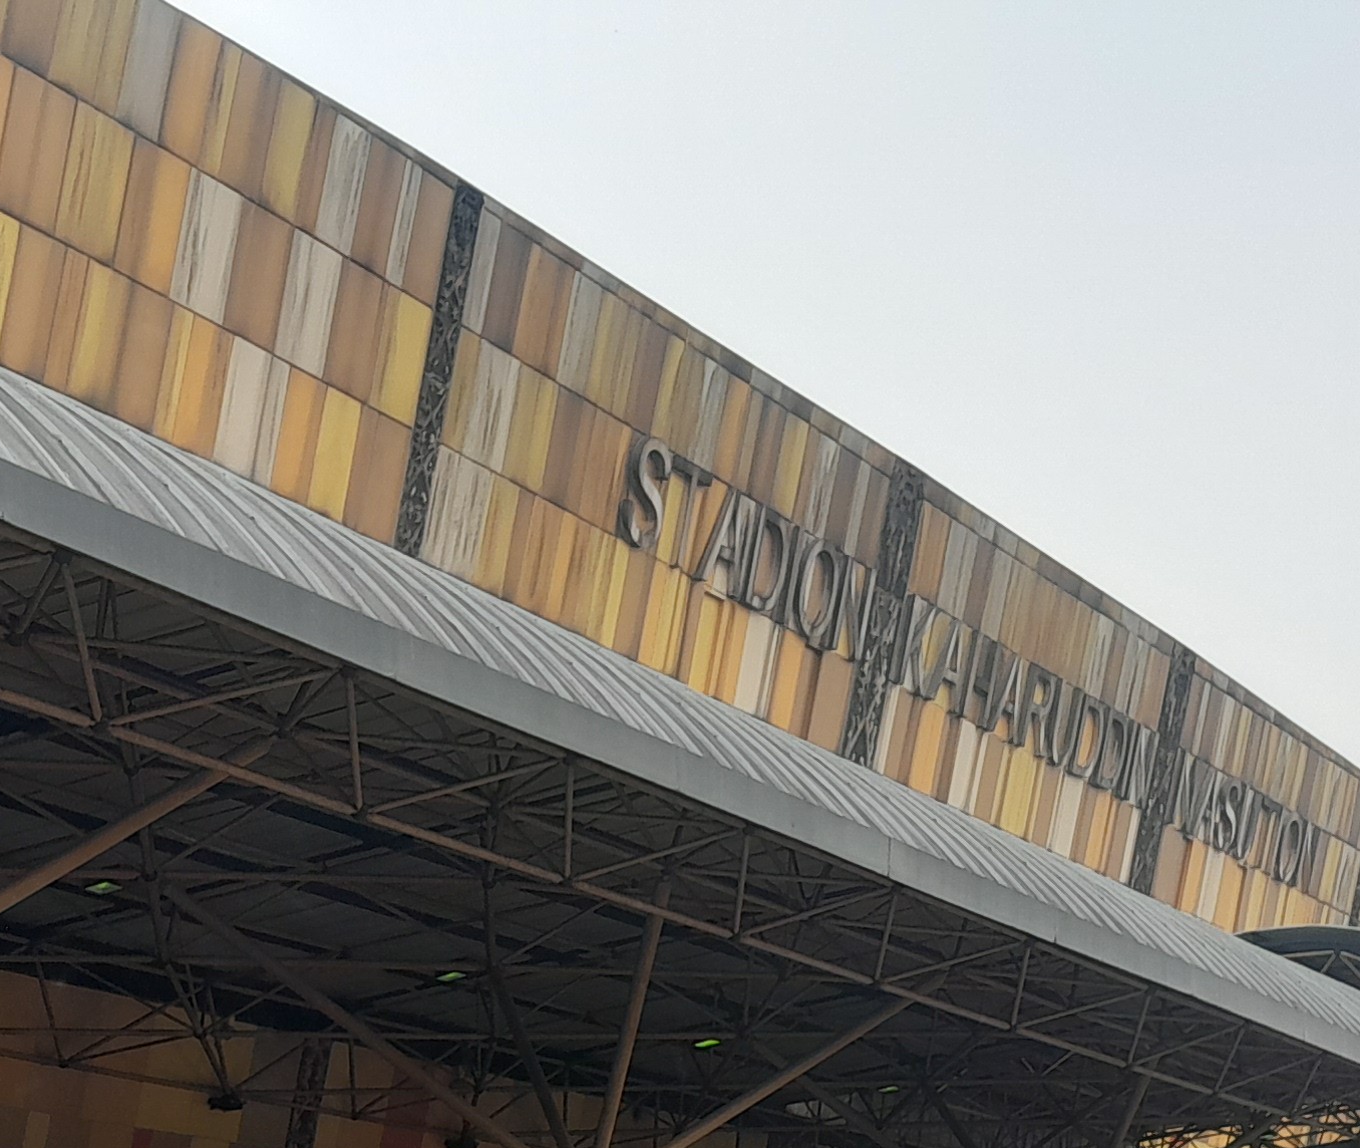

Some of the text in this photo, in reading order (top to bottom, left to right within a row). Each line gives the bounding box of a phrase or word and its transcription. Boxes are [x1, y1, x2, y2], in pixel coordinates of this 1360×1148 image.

[617, 436, 1320, 892] STADION KAHARUDDIN NASUTION
